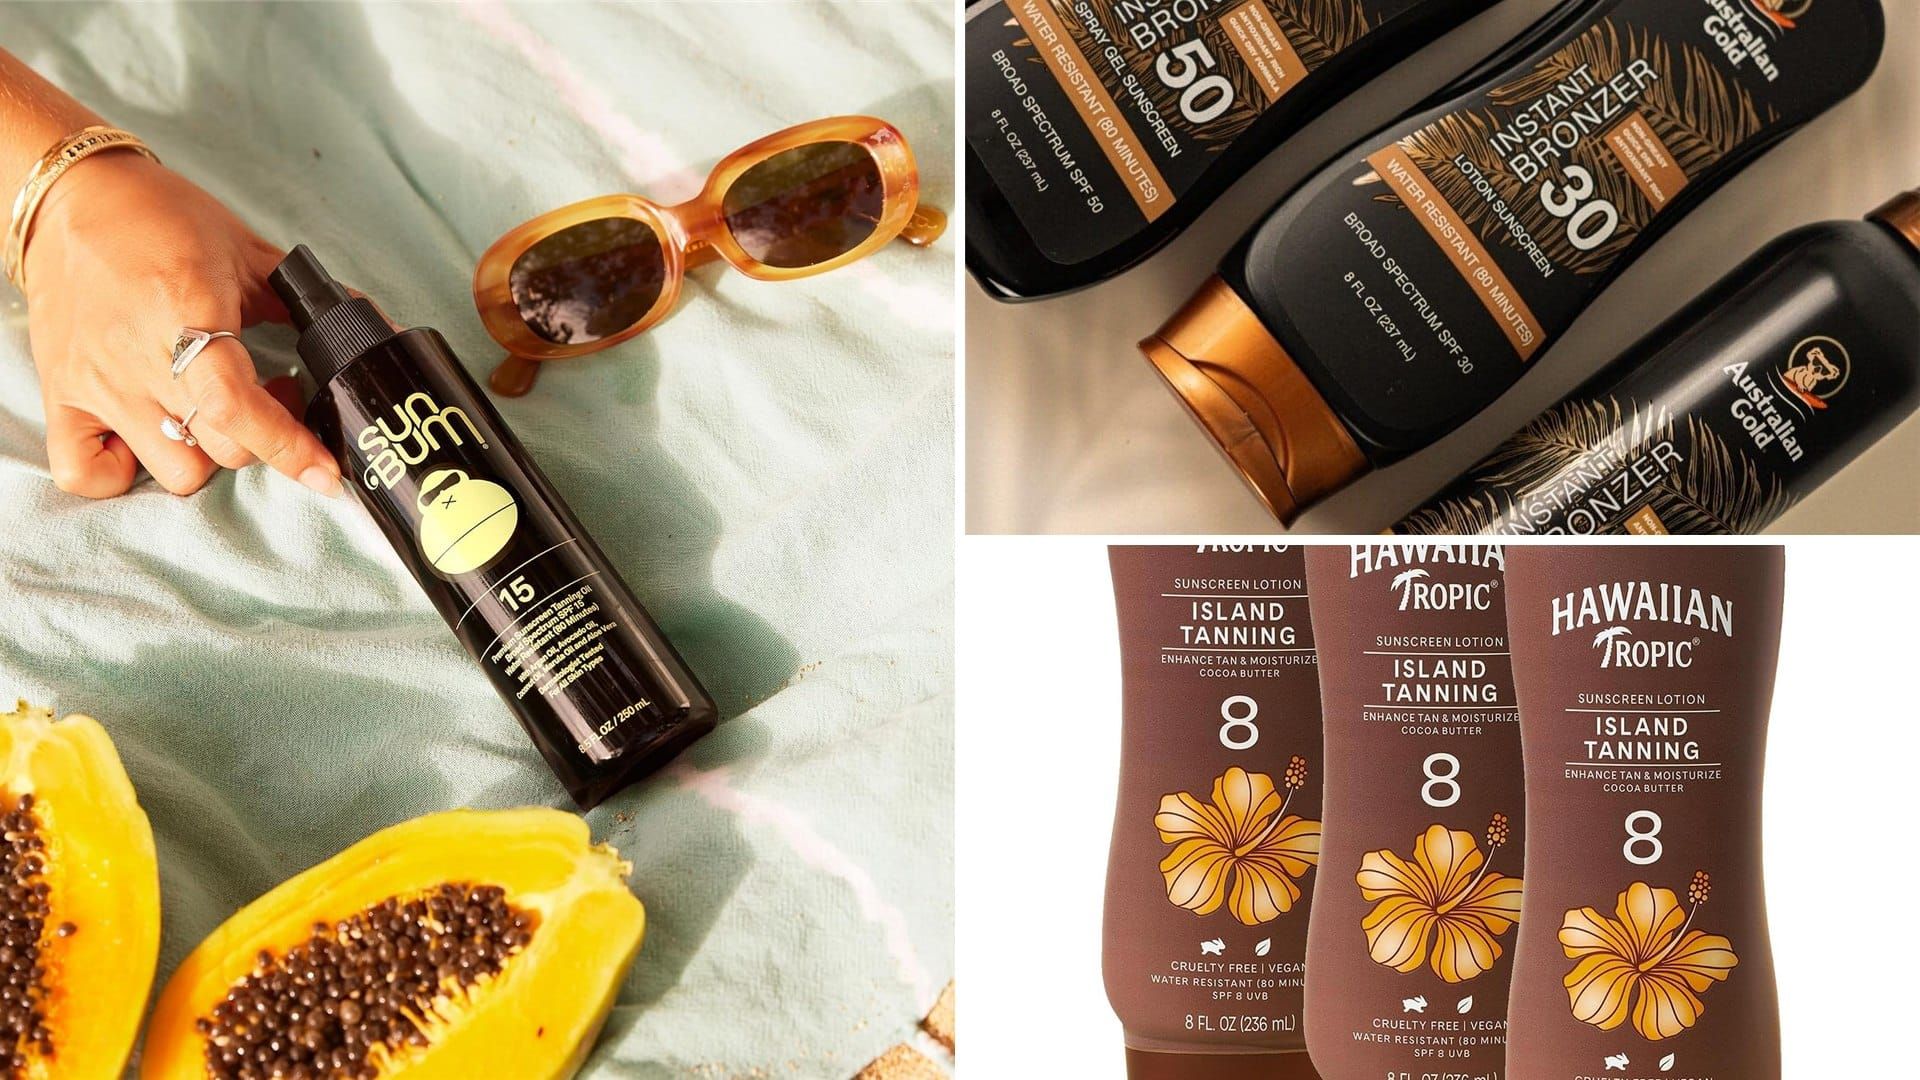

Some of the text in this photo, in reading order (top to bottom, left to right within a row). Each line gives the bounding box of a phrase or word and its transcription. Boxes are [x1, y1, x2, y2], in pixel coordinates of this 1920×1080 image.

[1238, 11, 1286, 79] ANTIOXIDANT RICH
[1248, 4, 1283, 51] NON-GREASY
[1703, 15, 1748, 67] Gold
[1705, 0, 1779, 82] ustralian
[1229, 17, 1280, 93] QUICK DRY FORMULA
[1023, 0, 1160, 204] WATER RESISTANT (80 MINUTES)
[1074, 2, 1111, 45] SPRAY
[1104, 45, 1127, 77] GEL
[1122, 74, 1183, 159] SUNSCREEN
[1155, 38, 1234, 124] 50
[991, 49, 1104, 214] BROAD SPECTRUM SPF 50
[1489, 63, 1595, 157] INSTANT
[1509, 59, 1658, 184] BRONZER
[991, 108, 1049, 193] 8 FL OZ (237 mL)
[1622, 127, 1656, 168] QUICK DRY
[1453, 153, 1555, 279] LOTION SUNSCREEN
[1540, 164, 1619, 251] 30
[1386, 158, 1535, 347] WATER RESISTANT (80 MINUTES)
[1343, 212, 1474, 375] BROAD SPECTRUM SPF 30
[1343, 271, 1417, 363] 8 FL OZ (237 mL)
[1723, 361, 1804, 463] Australian
[1730, 398, 1776, 450] Gold
[499, 575, 535, 611] 15
[1174, 578, 1302, 590] SUNSCREEN LOTION
[491, 584, 593, 664] Premium Sunscreen Tanning Oil
[504, 599, 585, 663] Broad Spectrum SPF 15
[1192, 601, 1284, 621] ISLAND
[1551, 581, 1734, 637] HAWAIIAN
[505, 602, 600, 677] Water Resistant (80 Minutes)
[1179, 625, 1296, 645] TANNING
[1376, 635, 1503, 648] SUNSCREEN LOTION
[538, 641, 604, 695] Dermatologist Tested
[549, 655, 604, 699] For All Skin Types
[1161, 654, 1213, 665] ENHANCE
[1215, 656, 1237, 666] TAN
[1239, 656, 1248, 666] &
[1199, 668, 1280, 678] COCOA BUTTER
[1394, 659, 1486, 679] ISLAND
[599, 720, 615, 735] OZ
[617, 705, 636, 723] 250
[634, 697, 651, 711] mL
[1382, 683, 1497, 703] TANNING
[1578, 693, 1705, 705] SUNSCREEN LOTION
[1219, 695, 1259, 750] 8
[1363, 711, 1415, 723] ENHANCE
[1417, 713, 1439, 723] TAN
[1441, 714, 1449, 723] &
[1401, 726, 1482, 735] COCOA BUTTER
[1596, 716, 1688, 736] ISLAND
[1583, 740, 1699, 760] TANNING
[1421, 752, 1461, 807] 8
[1565, 769, 1722, 780] ENHANCE TAN & MOISTURIZE
[1603, 783, 1684, 793] COCOA BUTTER
[1623, 809, 1663, 865] 8
[1150, 974, 1189, 986] WATER
[1192, 977, 1253, 988] RESISTANT
[1256, 978, 1275, 989] (80
[1170, 960, 1225, 973] CRUELTY
[1228, 963, 1258, 974] FREE
[1212, 991, 1269, 1001] SPF 8 UVB
[1184, 1014, 1296, 1033] 8 FL. OZ (236 mL)
[1352, 1032, 1391, 1043] WATER
[1394, 1035, 1455, 1046] RESISTANT
[1458, 1036, 1477, 1047] (80
[1372, 1018, 1426, 1030] CRUELTY
[1430, 1020, 1460, 1031] FREE
[1414, 1048, 1471, 1058] SPF 8 UVB
